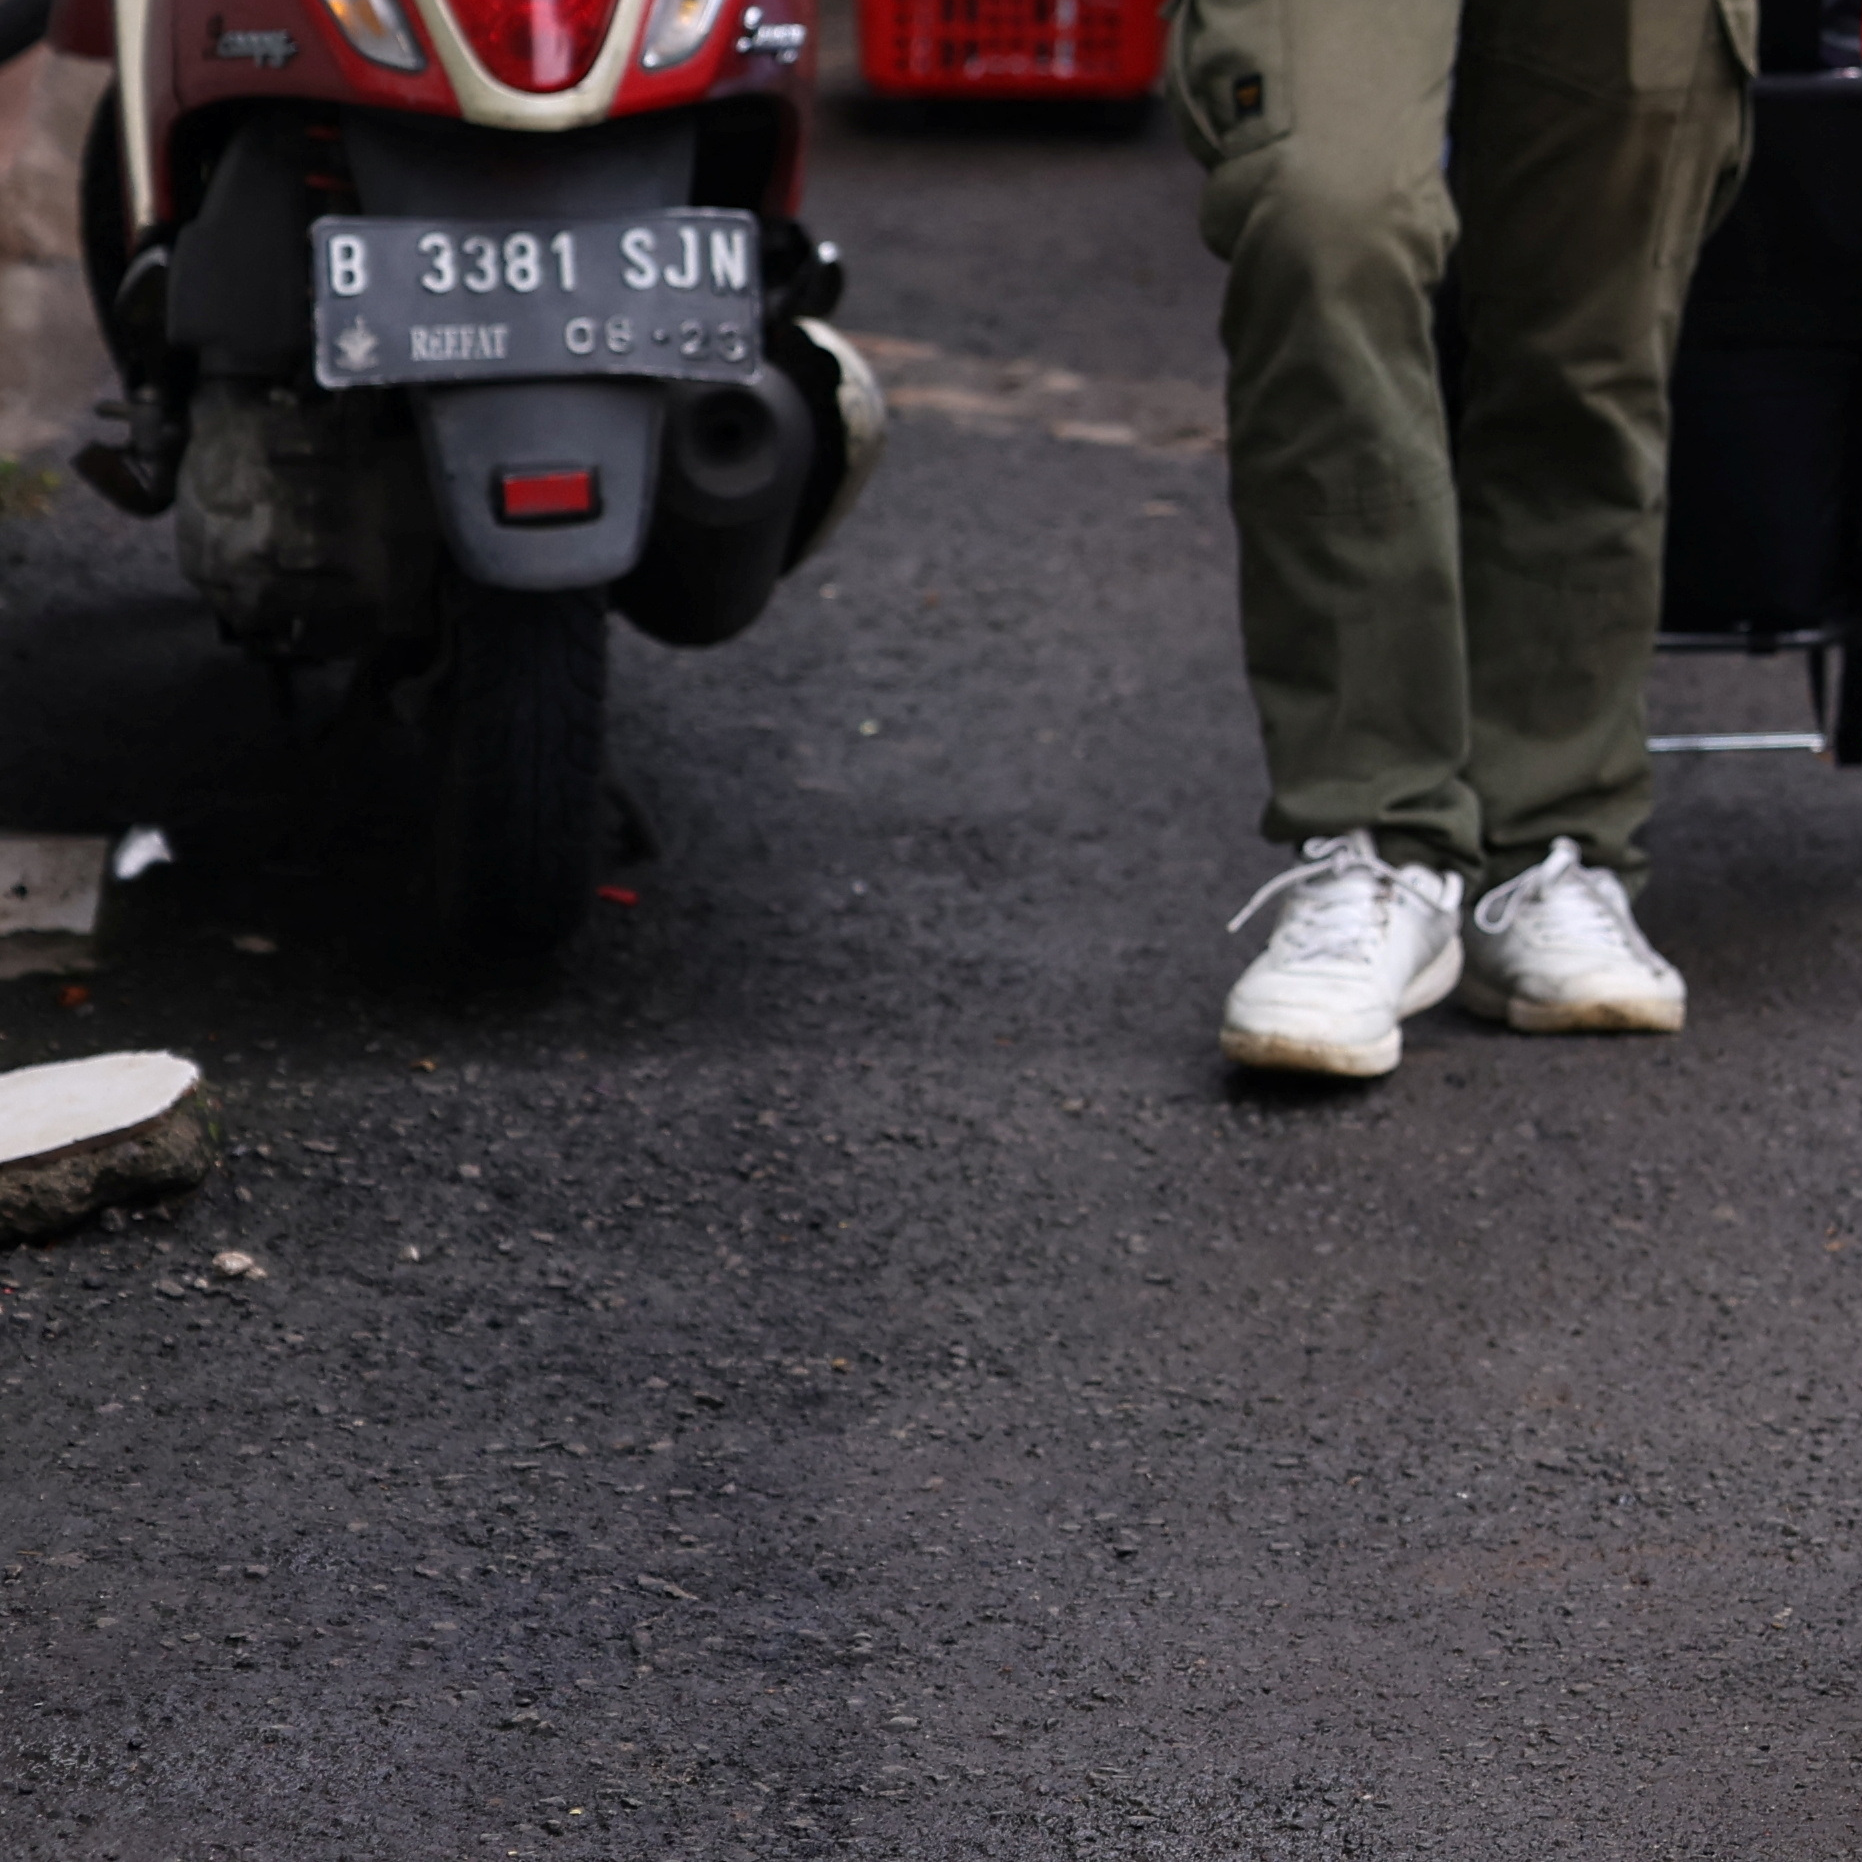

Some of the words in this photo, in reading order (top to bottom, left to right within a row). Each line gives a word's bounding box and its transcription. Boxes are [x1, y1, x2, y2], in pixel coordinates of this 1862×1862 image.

[329, 234, 368, 296] B
[418, 231, 578, 293] 3381
[620, 226, 748, 292] SJN
